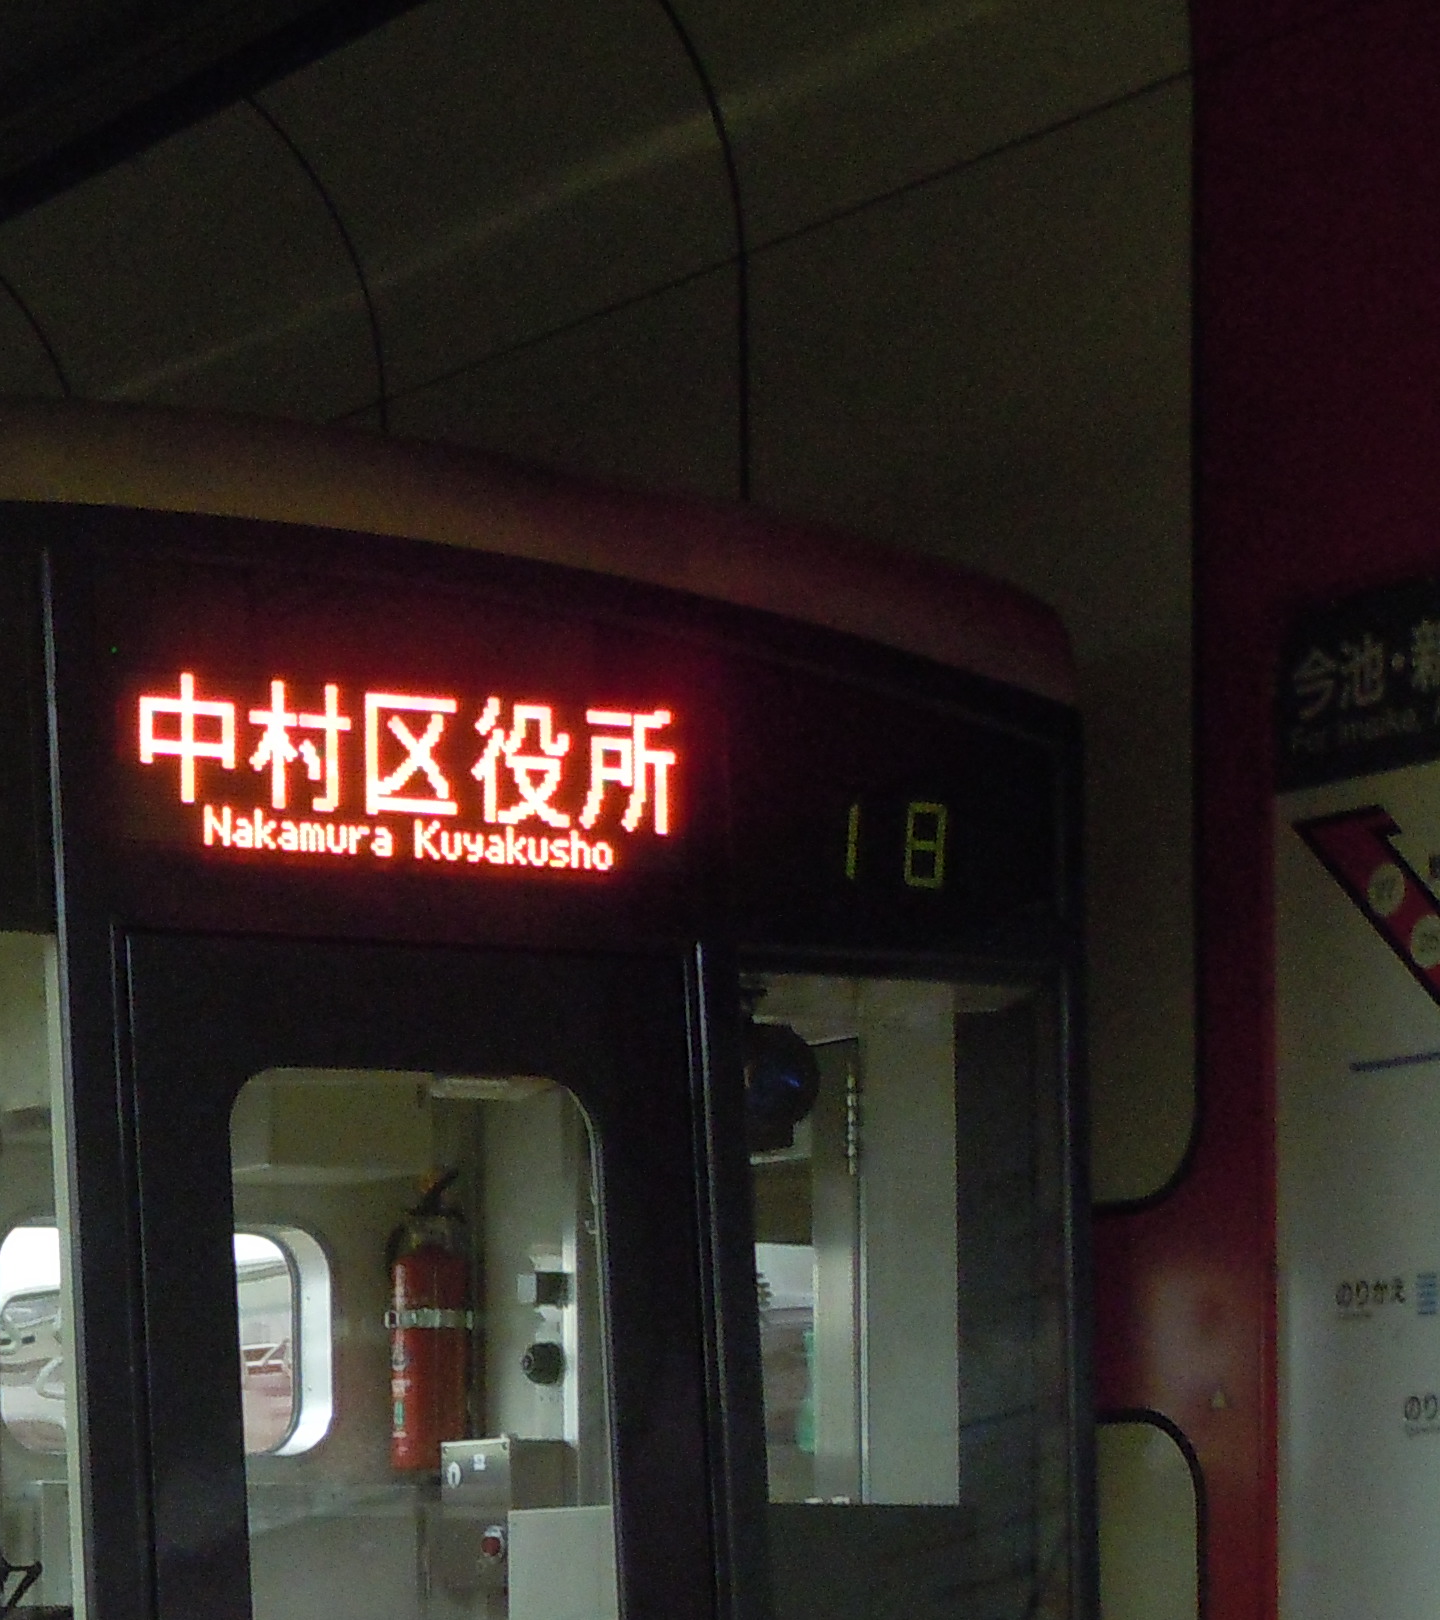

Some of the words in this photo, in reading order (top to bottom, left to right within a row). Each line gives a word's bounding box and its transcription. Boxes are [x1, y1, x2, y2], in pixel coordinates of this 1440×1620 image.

[138, 672, 676, 836] 中村区役所
[203, 804, 393, 858] Nakamura
[413, 819, 614, 871] Kuyakusho
[846, 801, 948, 888] 18
[1335, 1278, 1406, 1308] のりかえ
